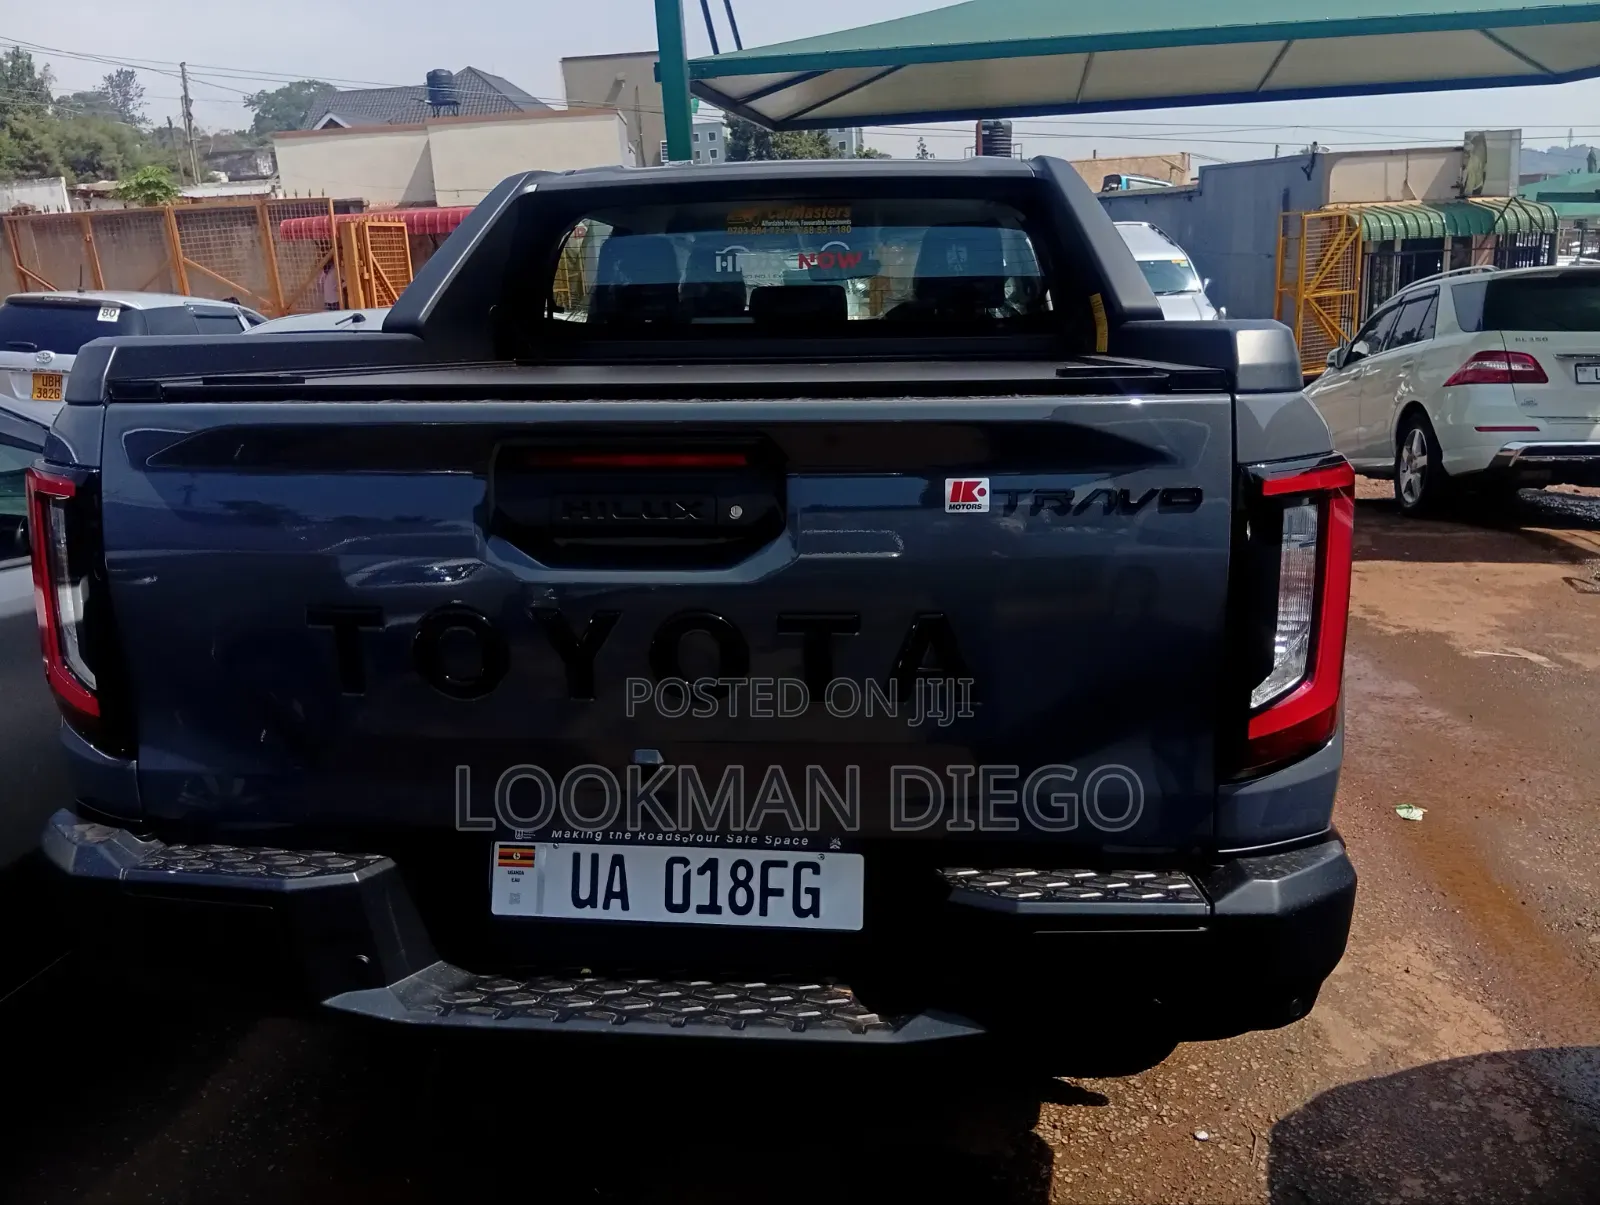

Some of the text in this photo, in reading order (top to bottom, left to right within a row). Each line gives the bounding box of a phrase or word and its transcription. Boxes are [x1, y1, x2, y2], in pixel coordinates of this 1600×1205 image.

[101, 308, 117, 317] 80
[41, 376, 61, 387] UBH
[36, 388, 60, 399] 382G
[562, 501, 704, 520] HILUX
[993, 488, 1204, 517] TRAVO
[306, 603, 982, 703] TOYOTA
[551, 830, 603, 842] Making
[764, 835, 809, 847] Space
[570, 852, 822, 919] UA 018FG
